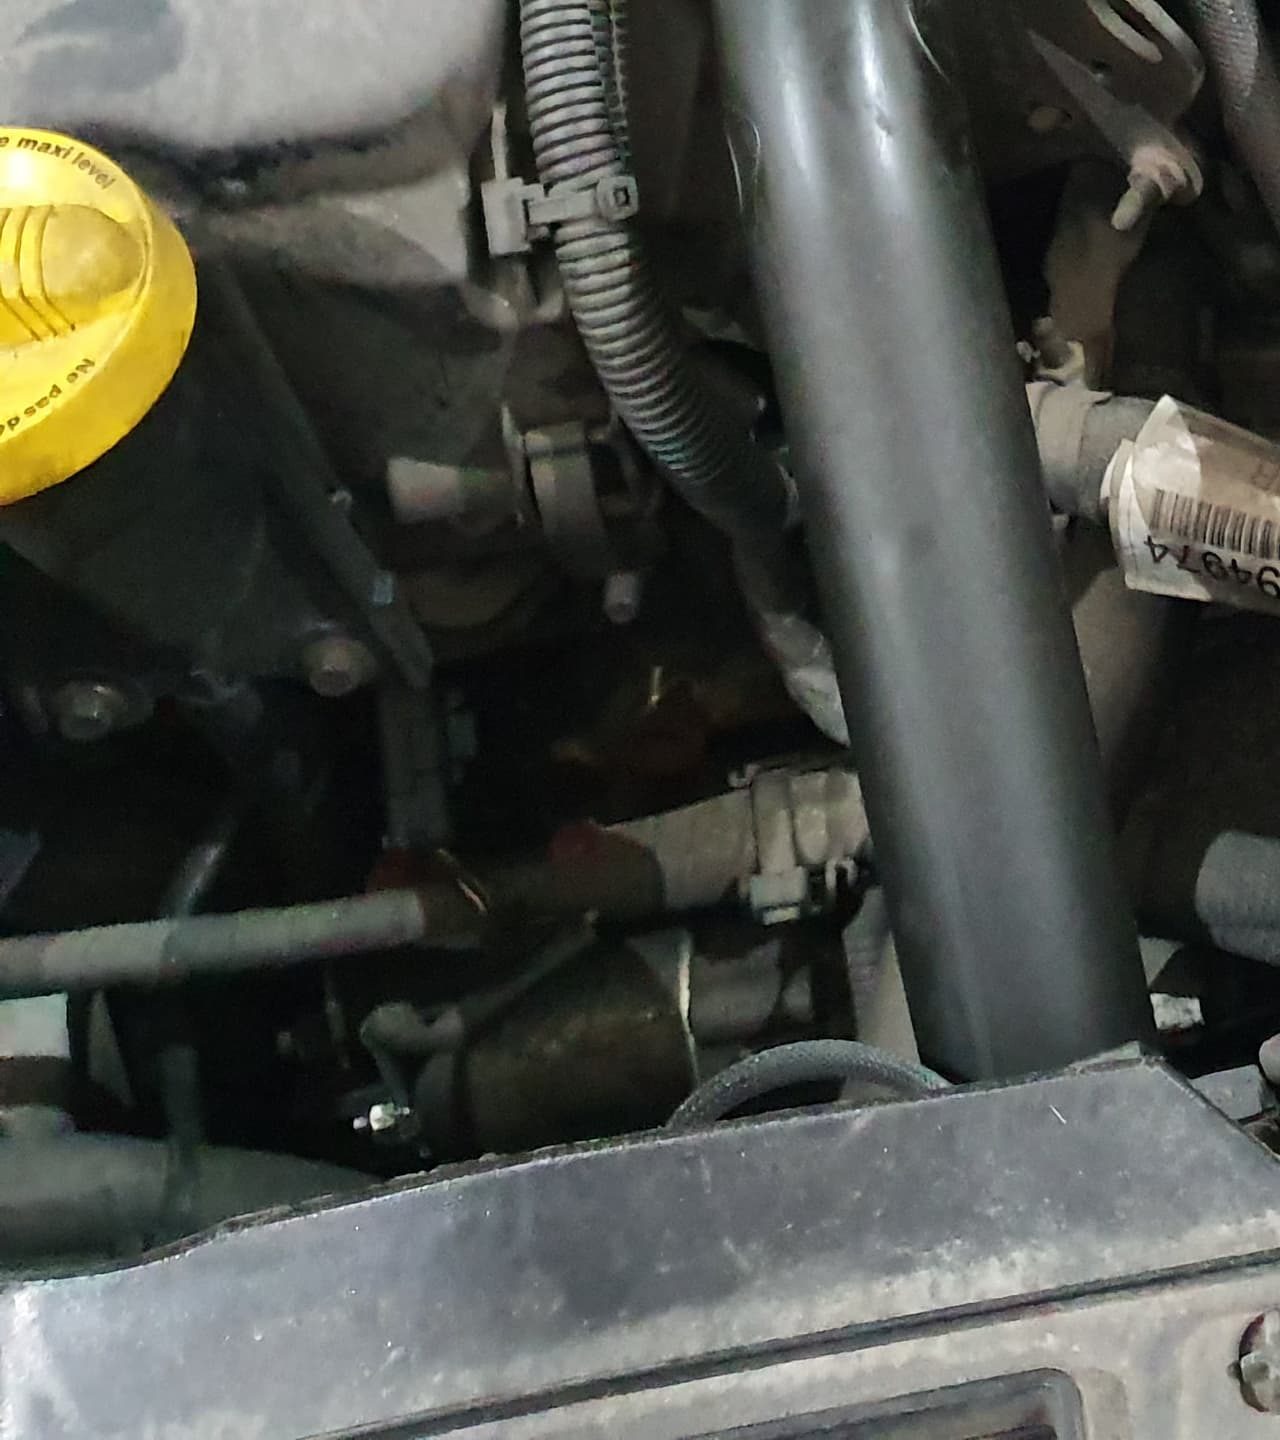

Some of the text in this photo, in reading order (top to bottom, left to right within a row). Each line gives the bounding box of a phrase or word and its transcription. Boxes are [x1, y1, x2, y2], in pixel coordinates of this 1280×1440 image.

[16, 137, 116, 189] maxi level
[23, 358, 96, 417] Ne pas
